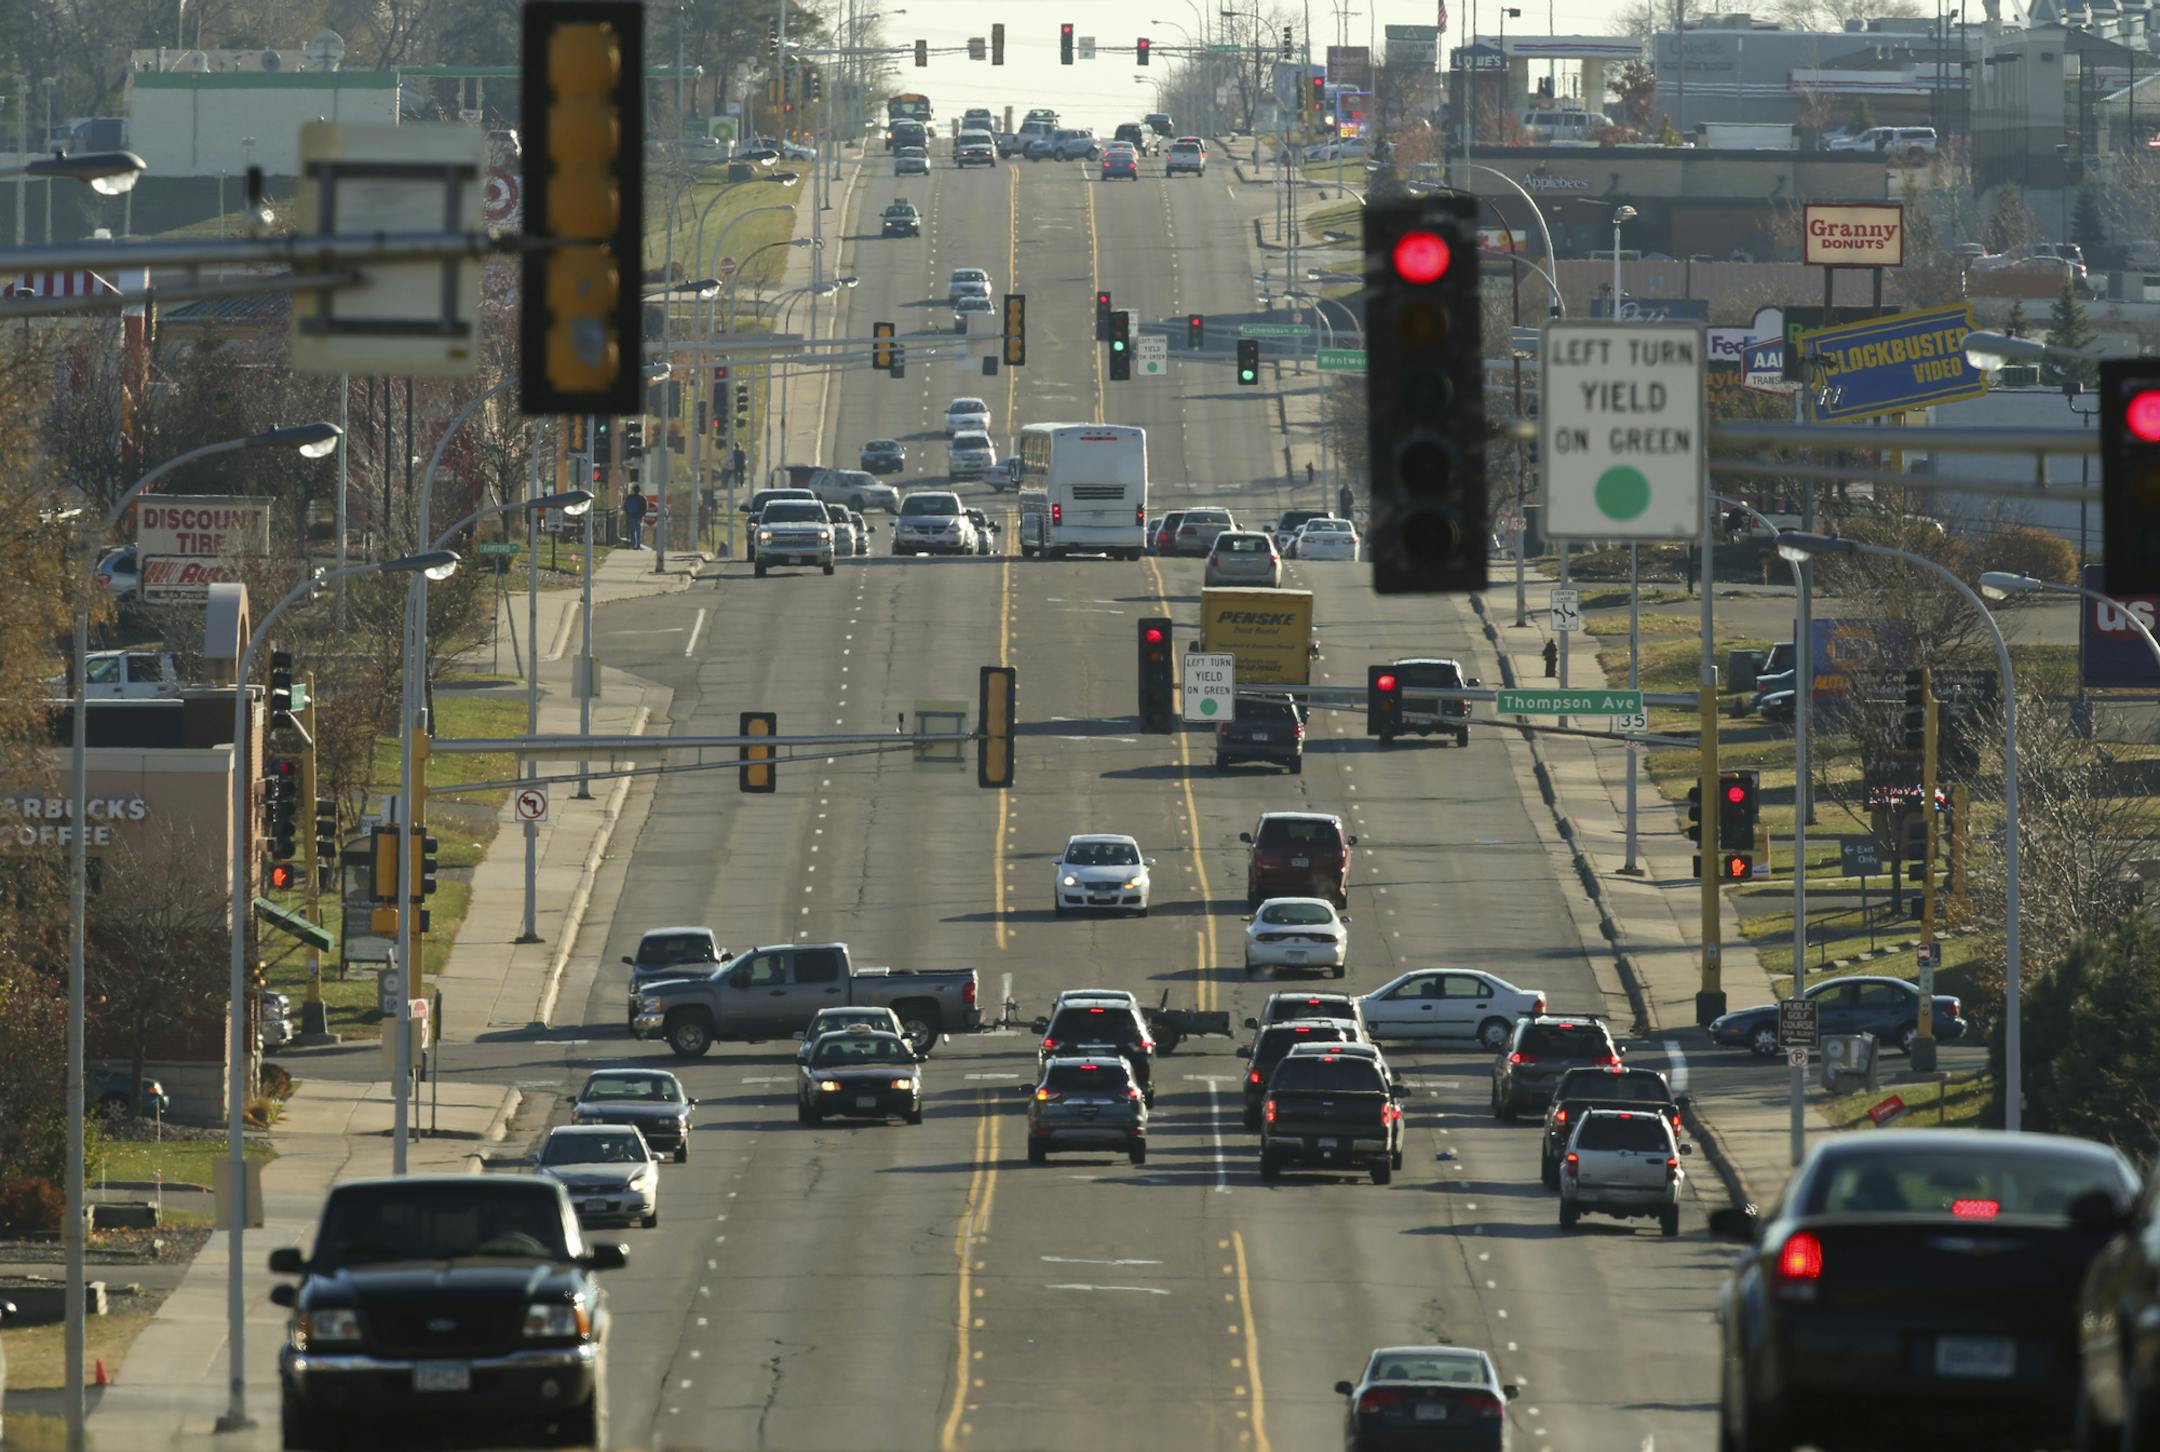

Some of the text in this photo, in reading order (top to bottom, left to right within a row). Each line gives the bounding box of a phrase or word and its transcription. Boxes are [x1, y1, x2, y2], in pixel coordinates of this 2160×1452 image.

[1809, 218, 1898, 241] Granny
[1821, 239, 1885, 249] DONUTS
[1552, 338, 1694, 367] LEFT TURN
[1911, 356, 1963, 384] VIDEO
[1581, 381, 1668, 414] YIELD
[1554, 426, 1692, 455] ON GREEN
[143, 507, 262, 530] DISCOUNT
[1216, 611, 1296, 625] PENSKE
[1187, 658, 1207, 667] LEFT
[1211, 658, 1231, 667] TURN
[1195, 672, 1222, 682] YIELD
[1187, 687, 1231, 695] ON GREEN
[1503, 695, 1635, 711] Thompson Ave
[1620, 714, 1646, 728] 35
[1857, 846, 1875, 854] Exit
[1857, 856, 1878, 865] Only
[1783, 1001, 1813, 1012] PUBLIC
[1787, 1011, 1809, 1020] GOLF
[1782, 1021, 1815, 1030] COURSE
